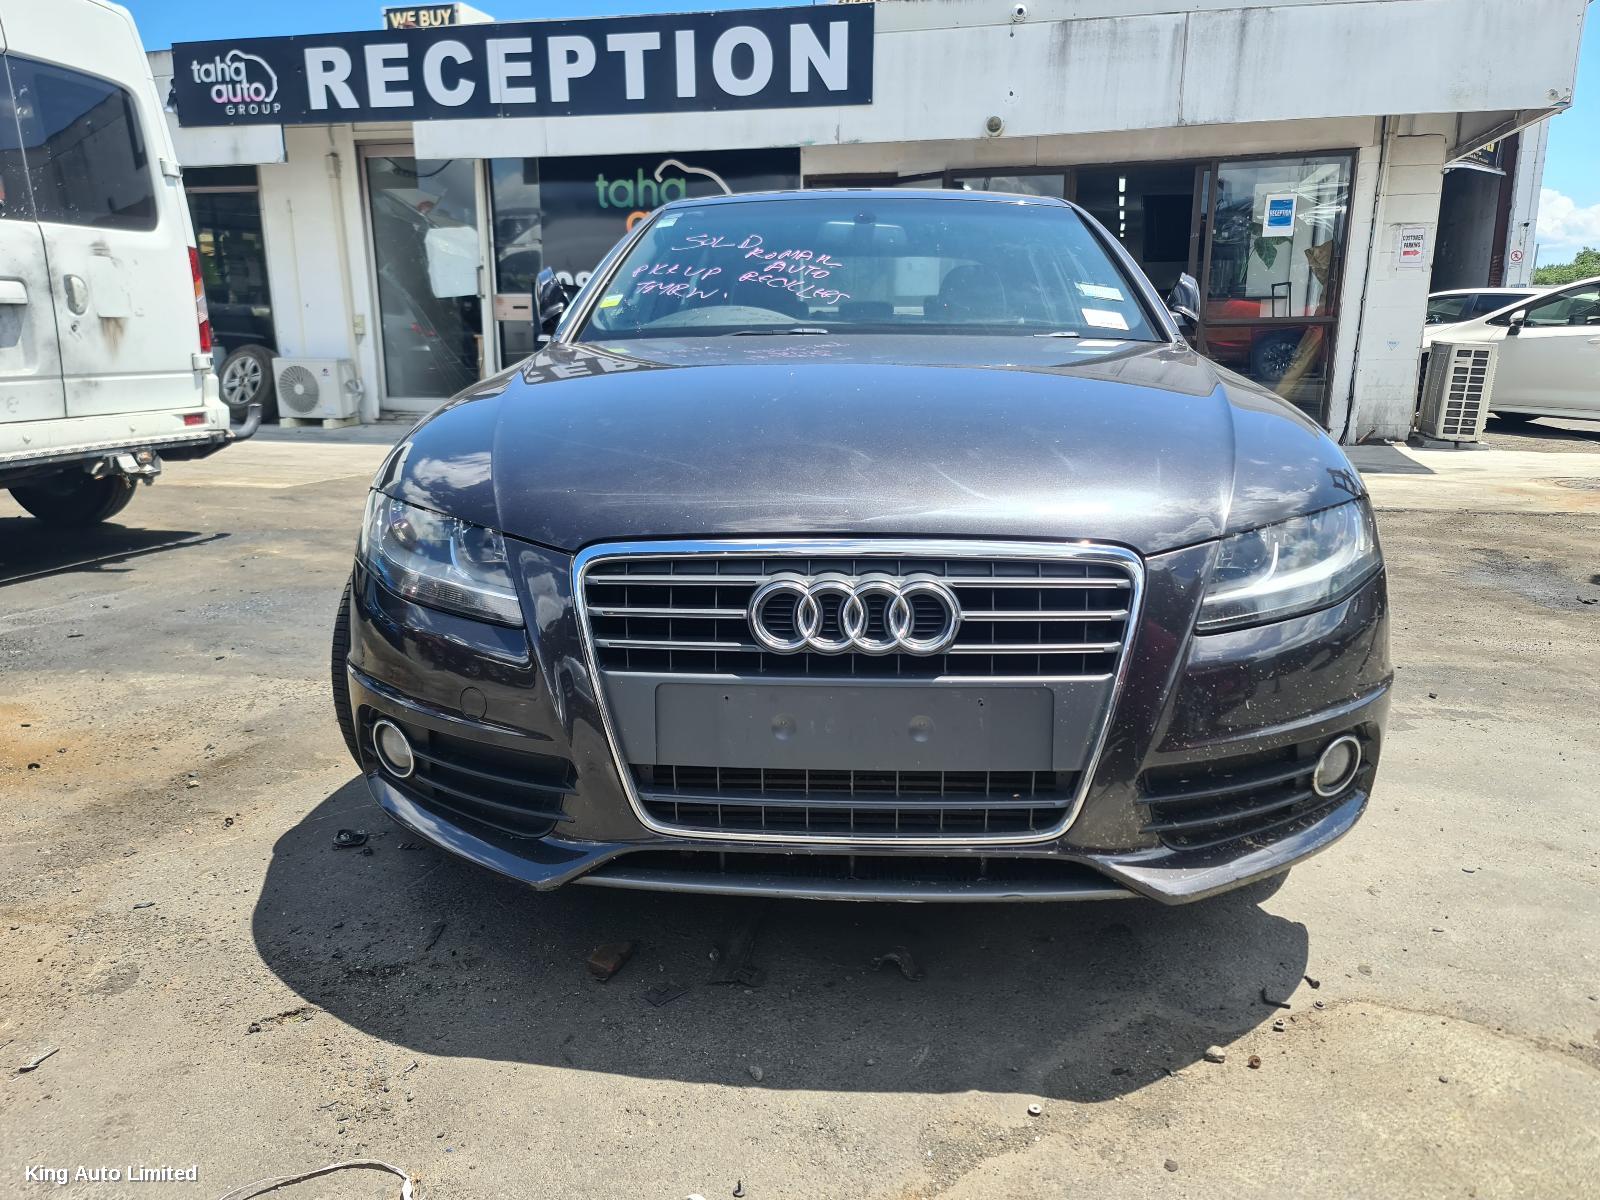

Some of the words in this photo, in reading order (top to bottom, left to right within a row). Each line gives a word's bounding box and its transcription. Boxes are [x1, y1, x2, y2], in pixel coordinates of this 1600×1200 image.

[389, 11, 416, 28] WE
[419, 8, 452, 26] BUY
[191, 56, 246, 84] taha
[304, 21, 849, 110] RECEPTION
[211, 81, 266, 103] auto
[225, 103, 281, 116] GROUP
[595, 168, 687, 208] taha
[671, 233, 763, 251] SOLD
[683, 266, 722, 280] UP
[763, 260, 830, 279] AUTO
